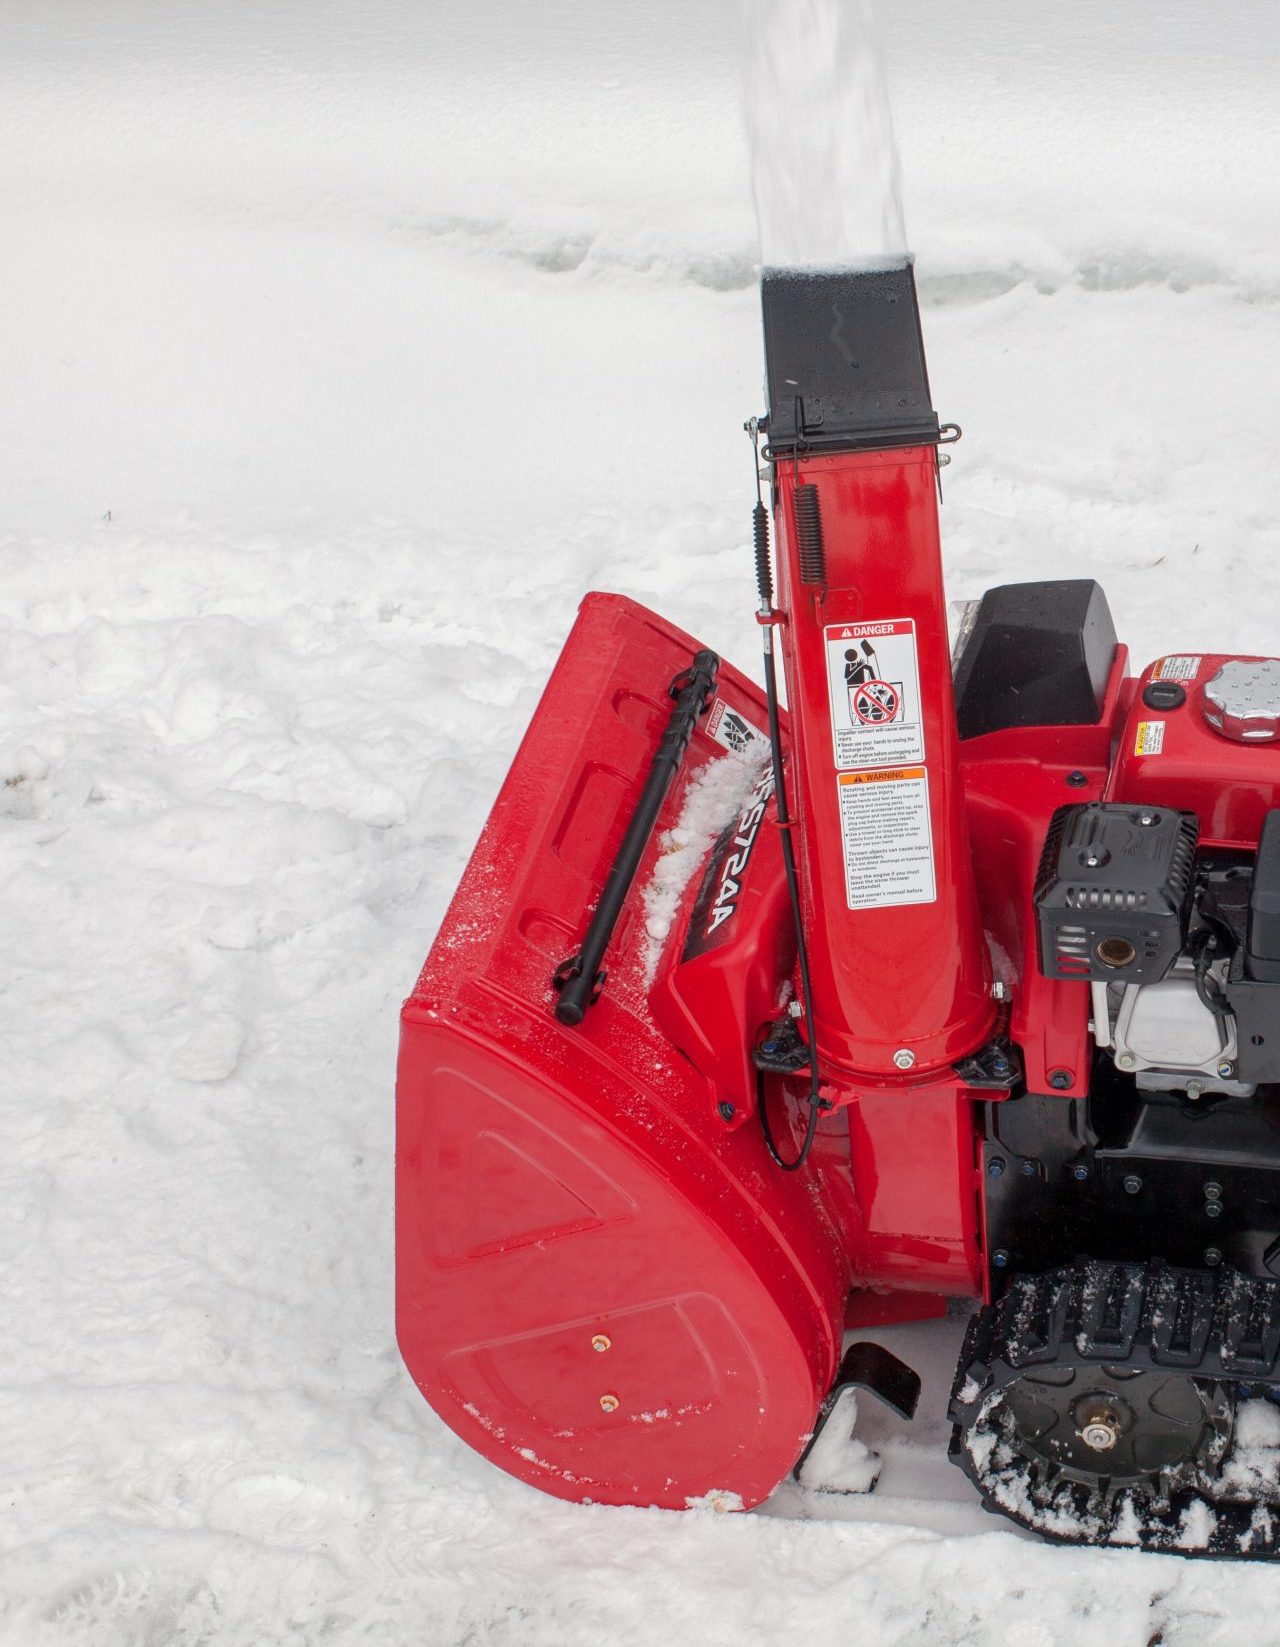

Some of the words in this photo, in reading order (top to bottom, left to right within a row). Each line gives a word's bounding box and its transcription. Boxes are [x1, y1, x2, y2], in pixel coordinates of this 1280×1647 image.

[853, 624, 895, 637] DANGER
[711, 703, 725, 728] DANGER
[866, 771, 904, 781] WARNING
